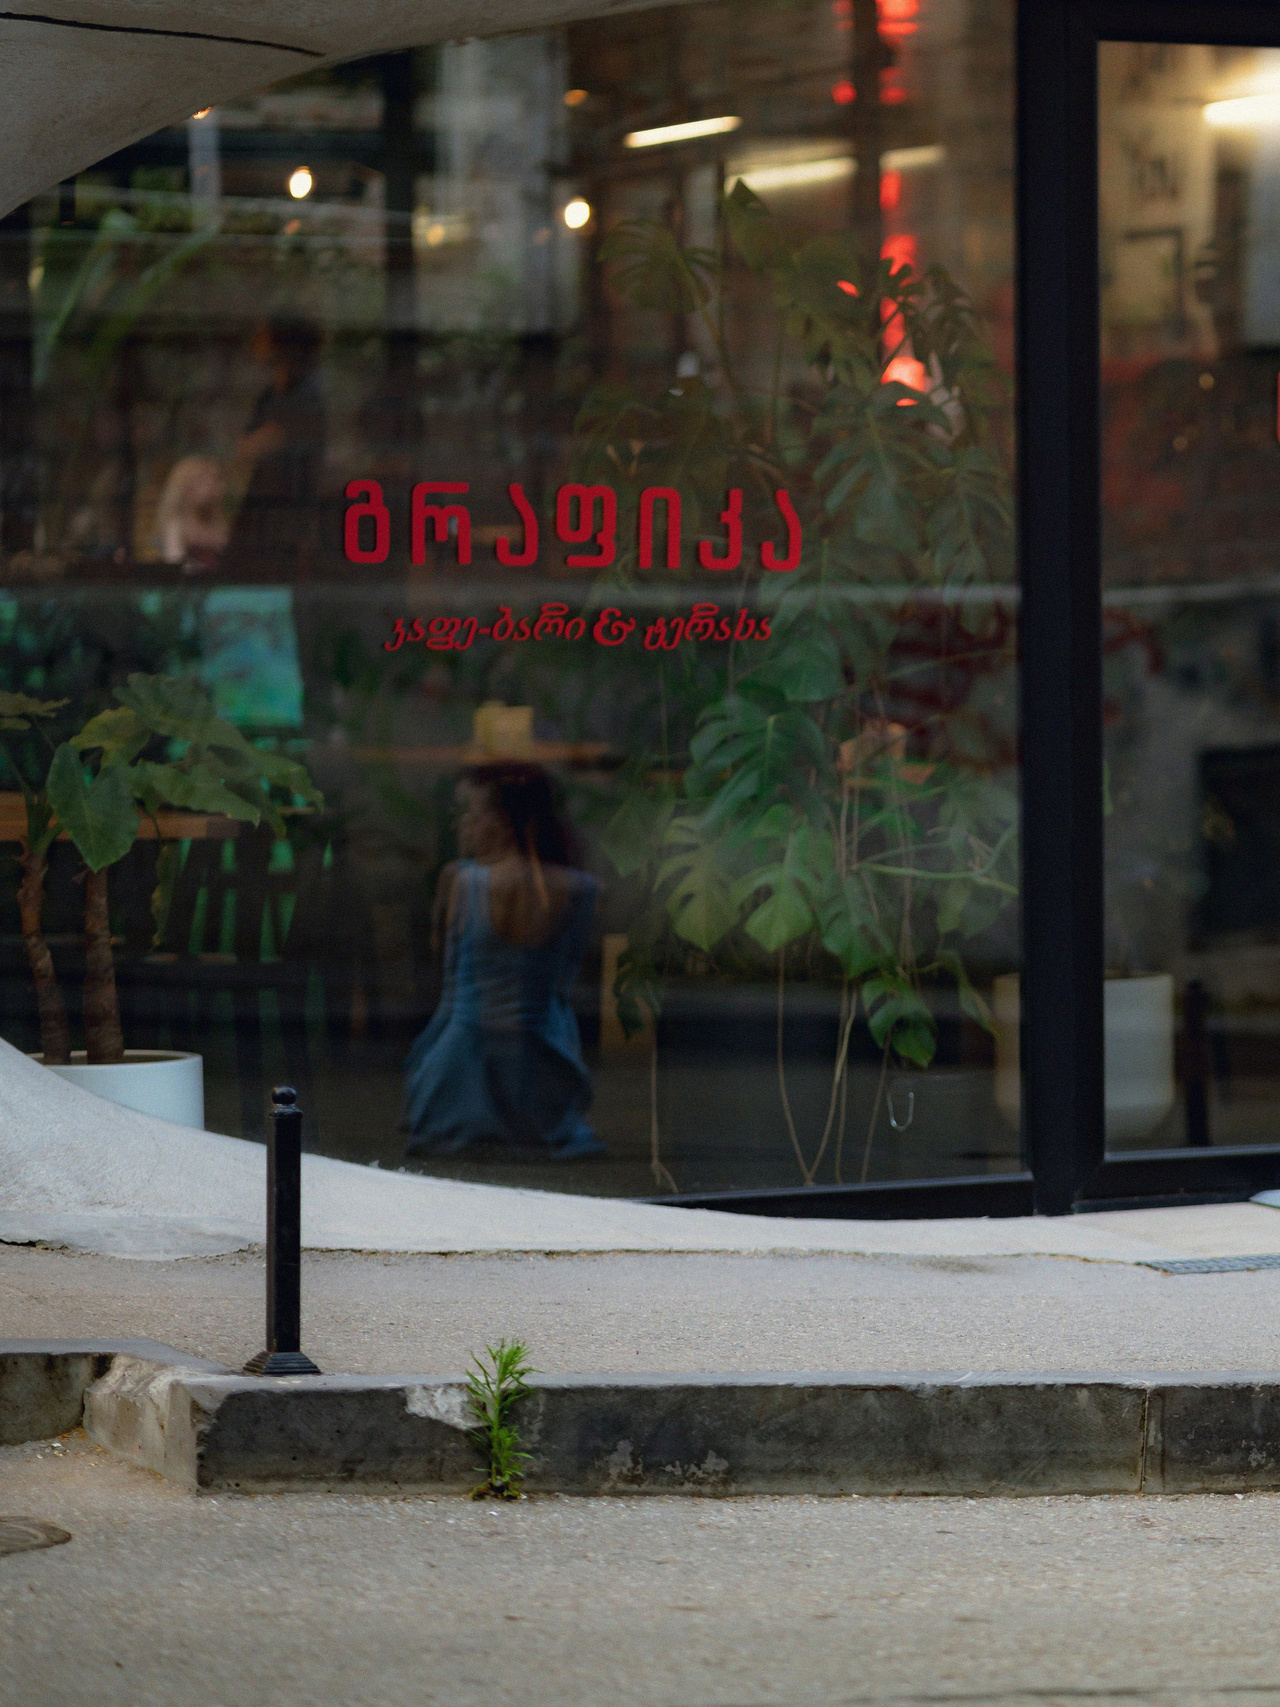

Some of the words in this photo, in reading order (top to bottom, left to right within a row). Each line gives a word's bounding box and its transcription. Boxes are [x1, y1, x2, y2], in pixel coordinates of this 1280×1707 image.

[344, 480, 802, 571] გრაფიკა
[593, 608, 635, 646] &
[644, 603, 772, 650] ტერასა
